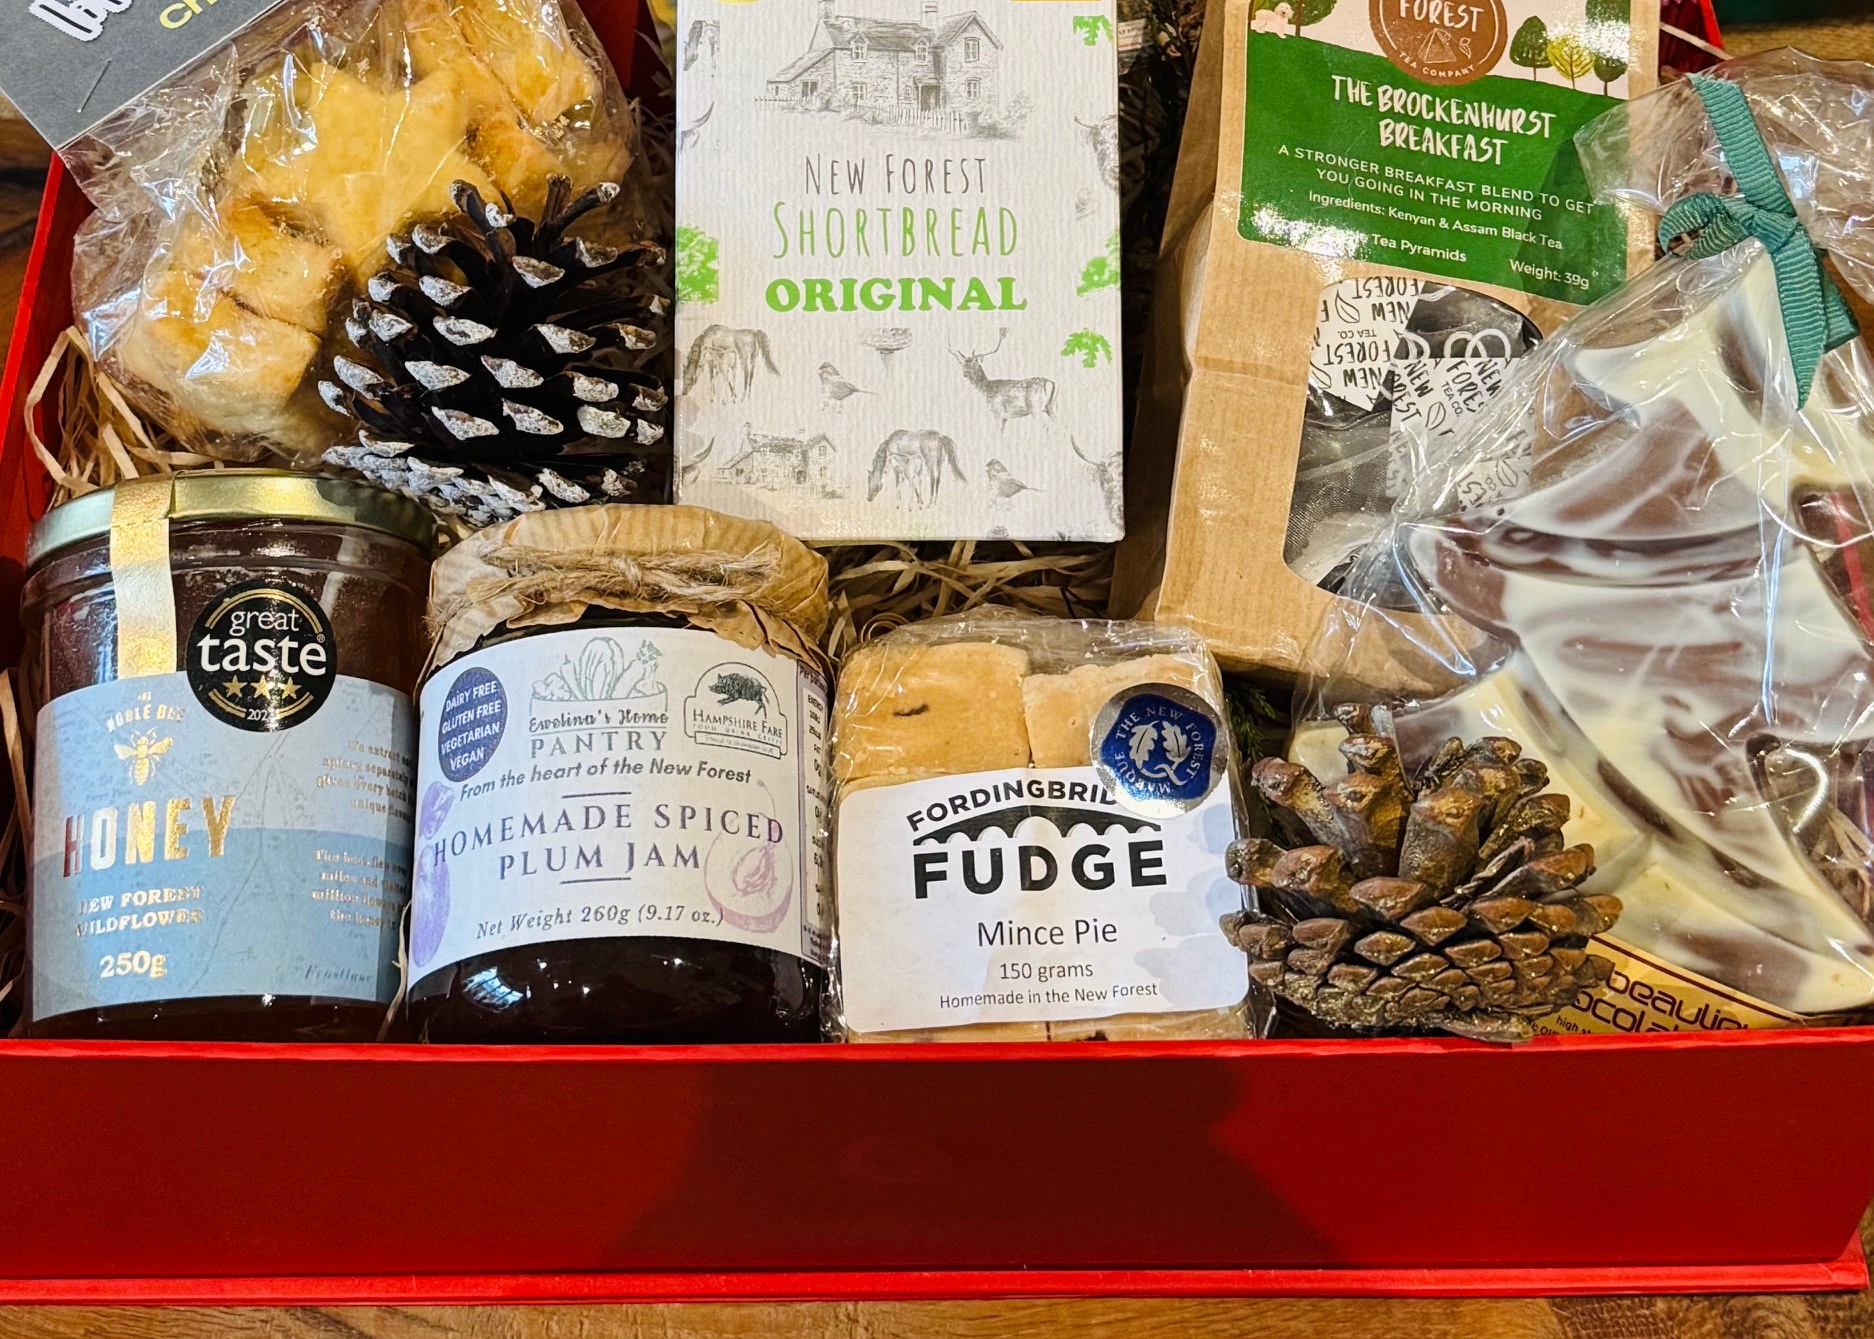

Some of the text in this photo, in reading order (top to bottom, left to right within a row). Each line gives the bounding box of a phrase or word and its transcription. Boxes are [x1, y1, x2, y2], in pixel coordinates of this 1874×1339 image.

[1398, 51, 1475, 78] TEA COMPANY
[1331, 74, 1558, 139] THE BROCKENHURST
[1377, 118, 1509, 166] BREAKFAST
[804, 152, 987, 195] NEW FOREST
[1278, 144, 1595, 216] A STRONGER BREAKFAST BLEND TO GET
[1315, 166, 1544, 221] YOU GOING IN THE MORNING
[772, 200, 1019, 260] SHORTBREAD
[1308, 189, 1563, 251] Ingredients: Kenyan & Assam Black Tea
[1371, 233, 1398, 250] Tea
[1400, 237, 1468, 264] Pyramids
[1508, 257, 1591, 291] Weight: 39g
[765, 276, 1028, 313] ORIGINAL
[1323, 339, 1392, 367] FOREST
[229, 608, 301, 637] great
[196, 633, 328, 677] taste
[445, 680, 499, 711] DAIRY FREE
[441, 699, 502, 735] GLUTEN FREE
[617, 708, 670, 727] Home
[692, 707, 758, 733] HAMPSHIRE
[761, 719, 784, 740] FARE
[440, 720, 503, 755] VEGETARIAN
[530, 730, 669, 759] PANTRY
[1115, 706, 1206, 780] THE NEW FOREST
[449, 746, 486, 771] VEGAN
[459, 756, 753, 803] From the heart of the New Forest
[62, 794, 238, 878] HONEY
[431, 801, 785, 868] HOMEMADE SPICED
[497, 839, 703, 882] PLUM JAM
[912, 839, 1168, 901] FUDGE
[475, 918, 504, 941] Net
[508, 908, 573, 935] Weight
[580, 903, 631, 926] 260g
[637, 903, 687, 926] (9.17
[976, 918, 1119, 948] Mince Pie
[99, 949, 168, 981] 250g
[999, 962, 1095, 985] 150 grams
[939, 982, 1160, 1011] Homemade in the New Forest
